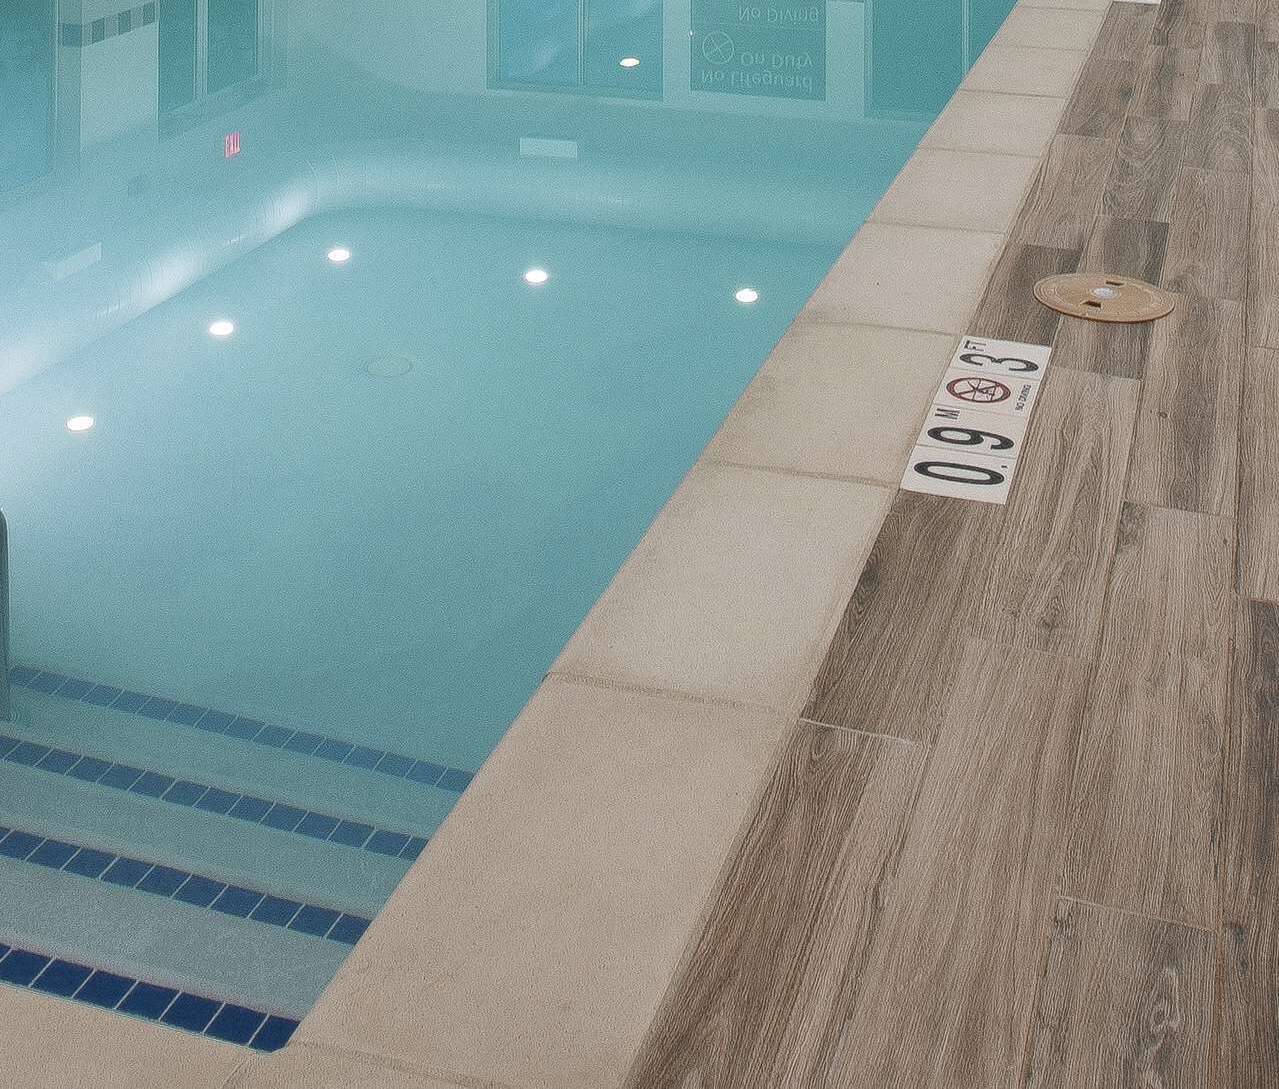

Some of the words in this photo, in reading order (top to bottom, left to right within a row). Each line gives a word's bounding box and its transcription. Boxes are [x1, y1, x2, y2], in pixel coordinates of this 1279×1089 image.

[963, 339, 987, 353] FT
[959, 352, 1039, 373] 3
[934, 407, 961, 421] M
